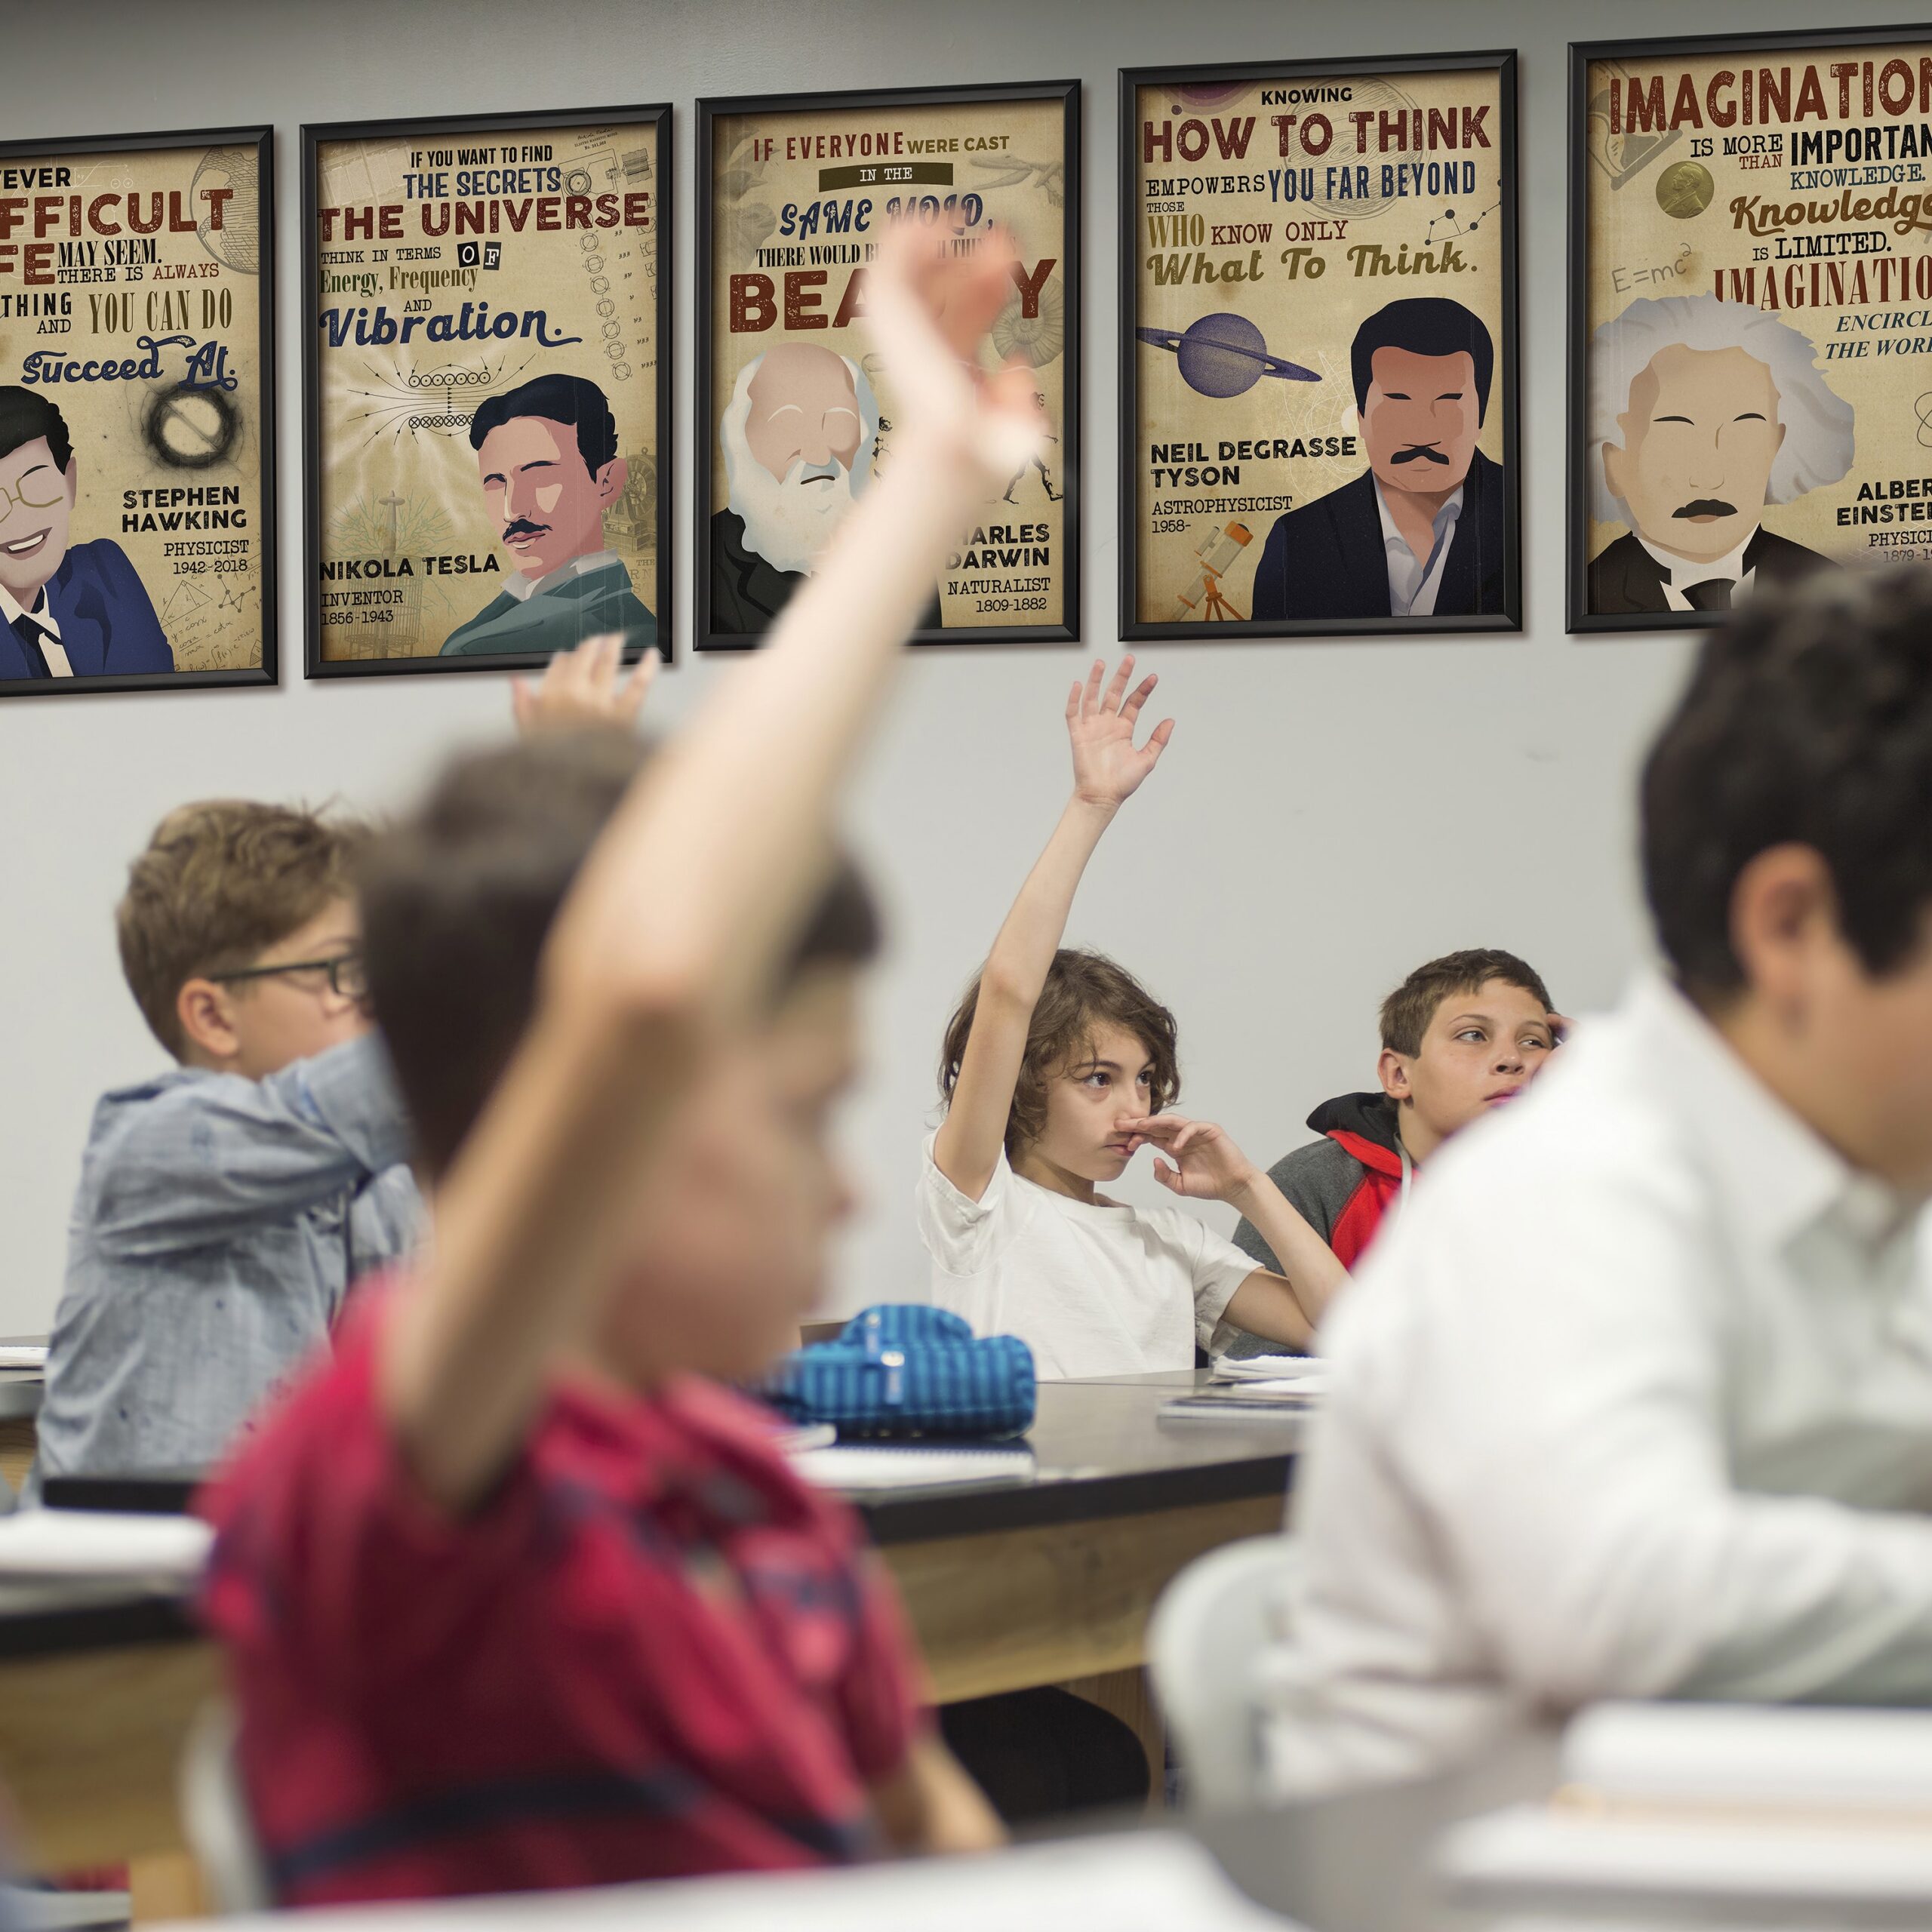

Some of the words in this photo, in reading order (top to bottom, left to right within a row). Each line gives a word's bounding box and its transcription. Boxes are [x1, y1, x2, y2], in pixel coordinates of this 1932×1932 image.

[1261, 87, 1352, 106] KNOWING
[1144, 116, 1257, 163] HOW
[1271, 113, 1333, 157] TO
[1349, 106, 1491, 154] THINK
[1690, 138, 1714, 158] IS
[1723, 134, 1783, 155] MORE
[411, 152, 423, 168] IF
[427, 150, 453, 168] YOU
[457, 148, 497, 166] WANT
[500, 147, 518, 164] TO
[521, 145, 553, 163] FIND
[754, 139, 774, 162] IF
[786, 131, 904, 161] EVERYONE
[907, 137, 958, 154] WERE
[964, 136, 1010, 152] CAST
[1739, 153, 1782, 170] THAN
[0, 168, 71, 189] EVER
[402, 173, 449, 199] THE
[456, 167, 561, 196] SECRETS
[860, 169, 877, 182] IN
[884, 167, 912, 181] THE
[1146, 174, 1266, 197] EMPOWERS
[1268, 168, 1314, 202] YOU
[1327, 165, 1369, 200] FAR
[1382, 161, 1476, 198] BEYOND
[1790, 164, 1927, 190] KNOWLEDGE.
[318, 205, 405, 242] THE
[421, 192, 650, 237] UNIVERSE
[1146, 201, 1185, 213] THOSE
[779, 198, 872, 240] SAME
[1147, 214, 1204, 248] WHO
[1211, 223, 1273, 246] KNOW
[1285, 220, 1349, 242] ONLY
[58, 240, 98, 268] MAY
[104, 238, 162, 265] SEEM.
[321, 250, 364, 265] THINK
[372, 248, 389, 263] IN
[396, 247, 441, 262] TERMS
[756, 247, 805, 268] THERE
[809, 244, 860, 266] WOULD
[1752, 248, 1769, 261] IS
[1775, 231, 1892, 260] LIMITED.
[57, 267, 115, 285] THERE
[125, 266, 143, 281] IS
[152, 263, 220, 281] ALWAYS
[1146, 249, 1265, 286] What
[1281, 248, 1326, 280] To
[1346, 242, 1478, 277] Think.
[320, 269, 384, 298] Energy,
[389, 266, 478, 292] Frequency
[404, 300, 432, 312] AND
[730, 258, 1057, 334] BEAY
[1, 292, 72, 317] THING
[88, 293, 135, 334] YOU
[146, 290, 190, 332] CAN
[201, 288, 232, 330] DO
[36, 318, 72, 334] AND
[318, 302, 583, 348] Vibration.
[20, 334, 197, 385] Succeed
[1826, 341, 1870, 360] THE
[1150, 442, 1208, 464] NEIL
[1218, 436, 1357, 460] DEGRASSE
[1150, 466, 1241, 488] TYSON
[123, 485, 240, 509] STEPHEN
[1152, 496, 1293, 515] ASTROPHYSICIST
[122, 509, 248, 533] HAWKING
[1152, 520, 1192, 534] 1958-
[163, 539, 250, 557] PHYSICIST
[946, 547, 1050, 570] DARWIN
[1883, 549, 1932, 563] 1879-1
[173, 559, 248, 574] 1942-2018
[320, 558, 414, 581] NIKOLA
[423, 554, 500, 576] TESLA
[948, 577, 1051, 595] NATURALIST
[321, 589, 404, 608] INVENTOR
[976, 598, 1048, 612] 1809-1882
[321, 610, 394, 626] 1856-1943
